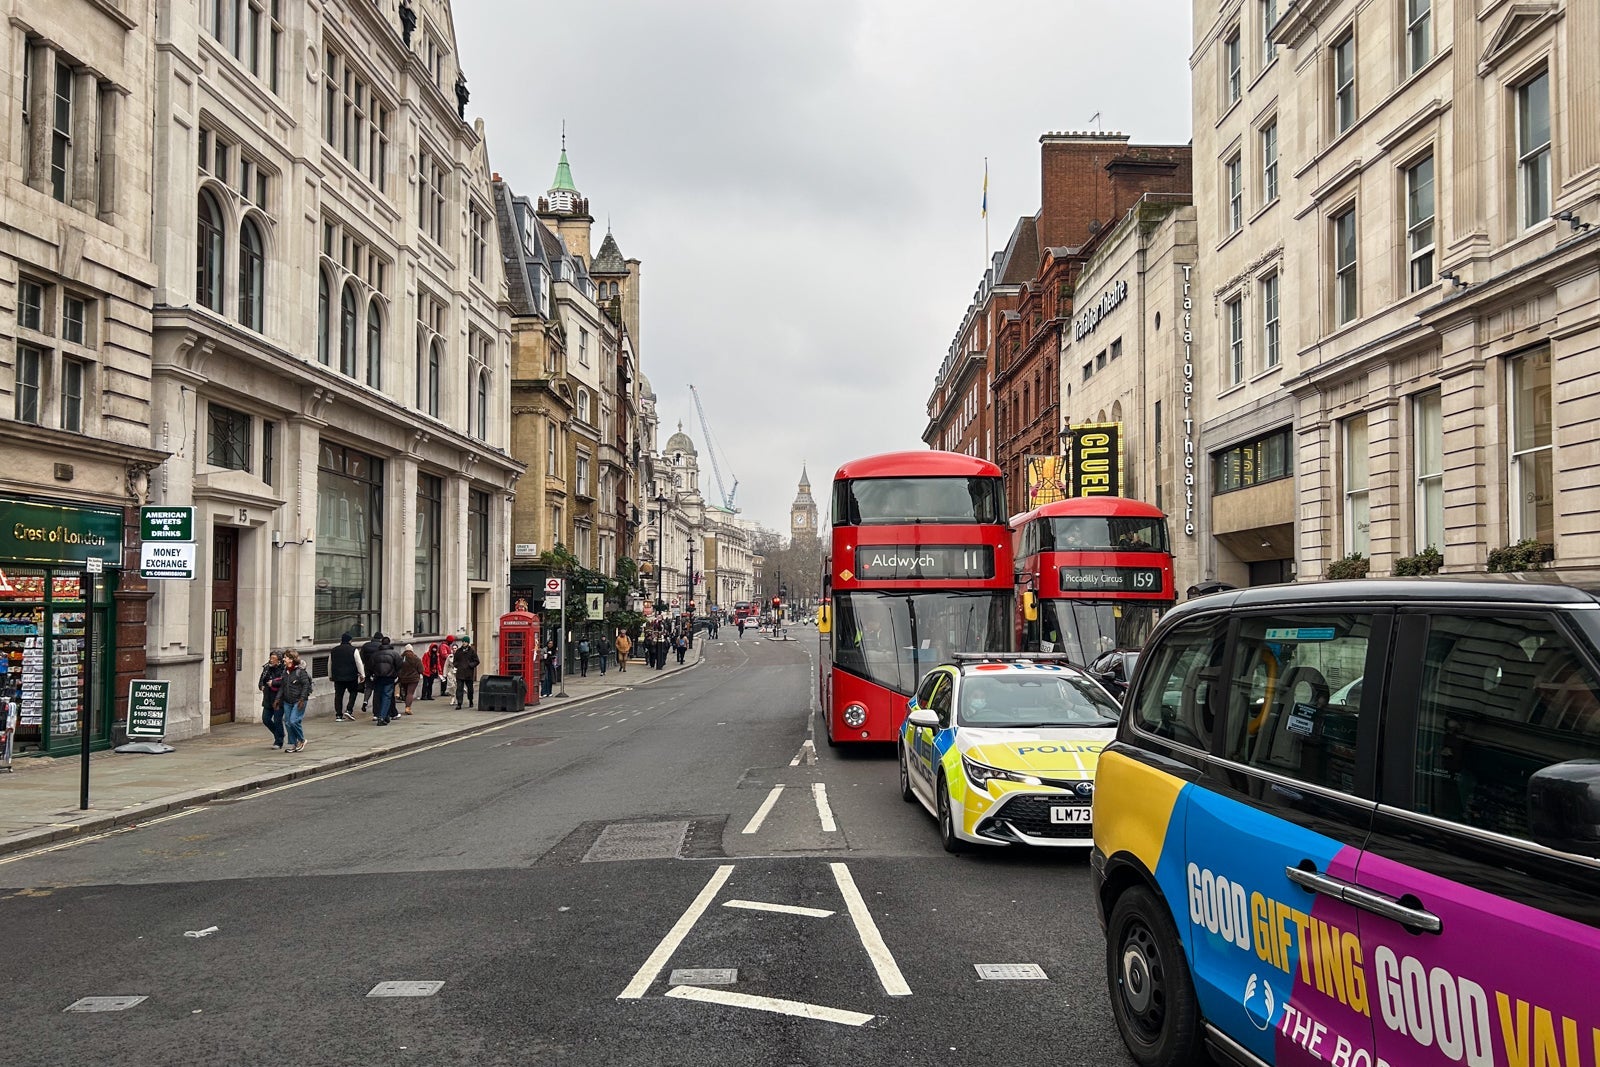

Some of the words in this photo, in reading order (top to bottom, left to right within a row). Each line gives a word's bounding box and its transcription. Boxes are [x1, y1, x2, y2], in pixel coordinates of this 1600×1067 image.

[1075, 305, 1100, 342] Trafalgar
[1100, 280, 1127, 319] Theatre
[1183, 265, 1193, 408] Trafalgar
[1184, 419, 1194, 535] Theatre
[145, 511, 187, 519] AMERICAN
[239, 508, 247, 523] 15
[13, 522, 47, 541] Crest
[48, 526, 62, 542] of
[64, 527, 105, 546] London
[153, 548, 182, 557] MONEY
[871, 554, 935, 570] Aldwych
[963, 550, 977, 570] 11
[146, 559, 187, 568] EXCHANGE
[1065, 573, 1099, 585] Piccadilly
[1100, 574, 1123, 583] Circus
[1133, 572, 1154, 588] 159
[135, 691, 166, 699] EXCHANGE
[143, 698, 156, 706] 0%
[1055, 808, 1091, 822] LM73
[1187, 862, 1250, 951] GOOD
[1251, 890, 1371, 1018] GIFTING
[1375, 945, 1494, 1067] GOOD
[1282, 1002, 1328, 1061] THE
